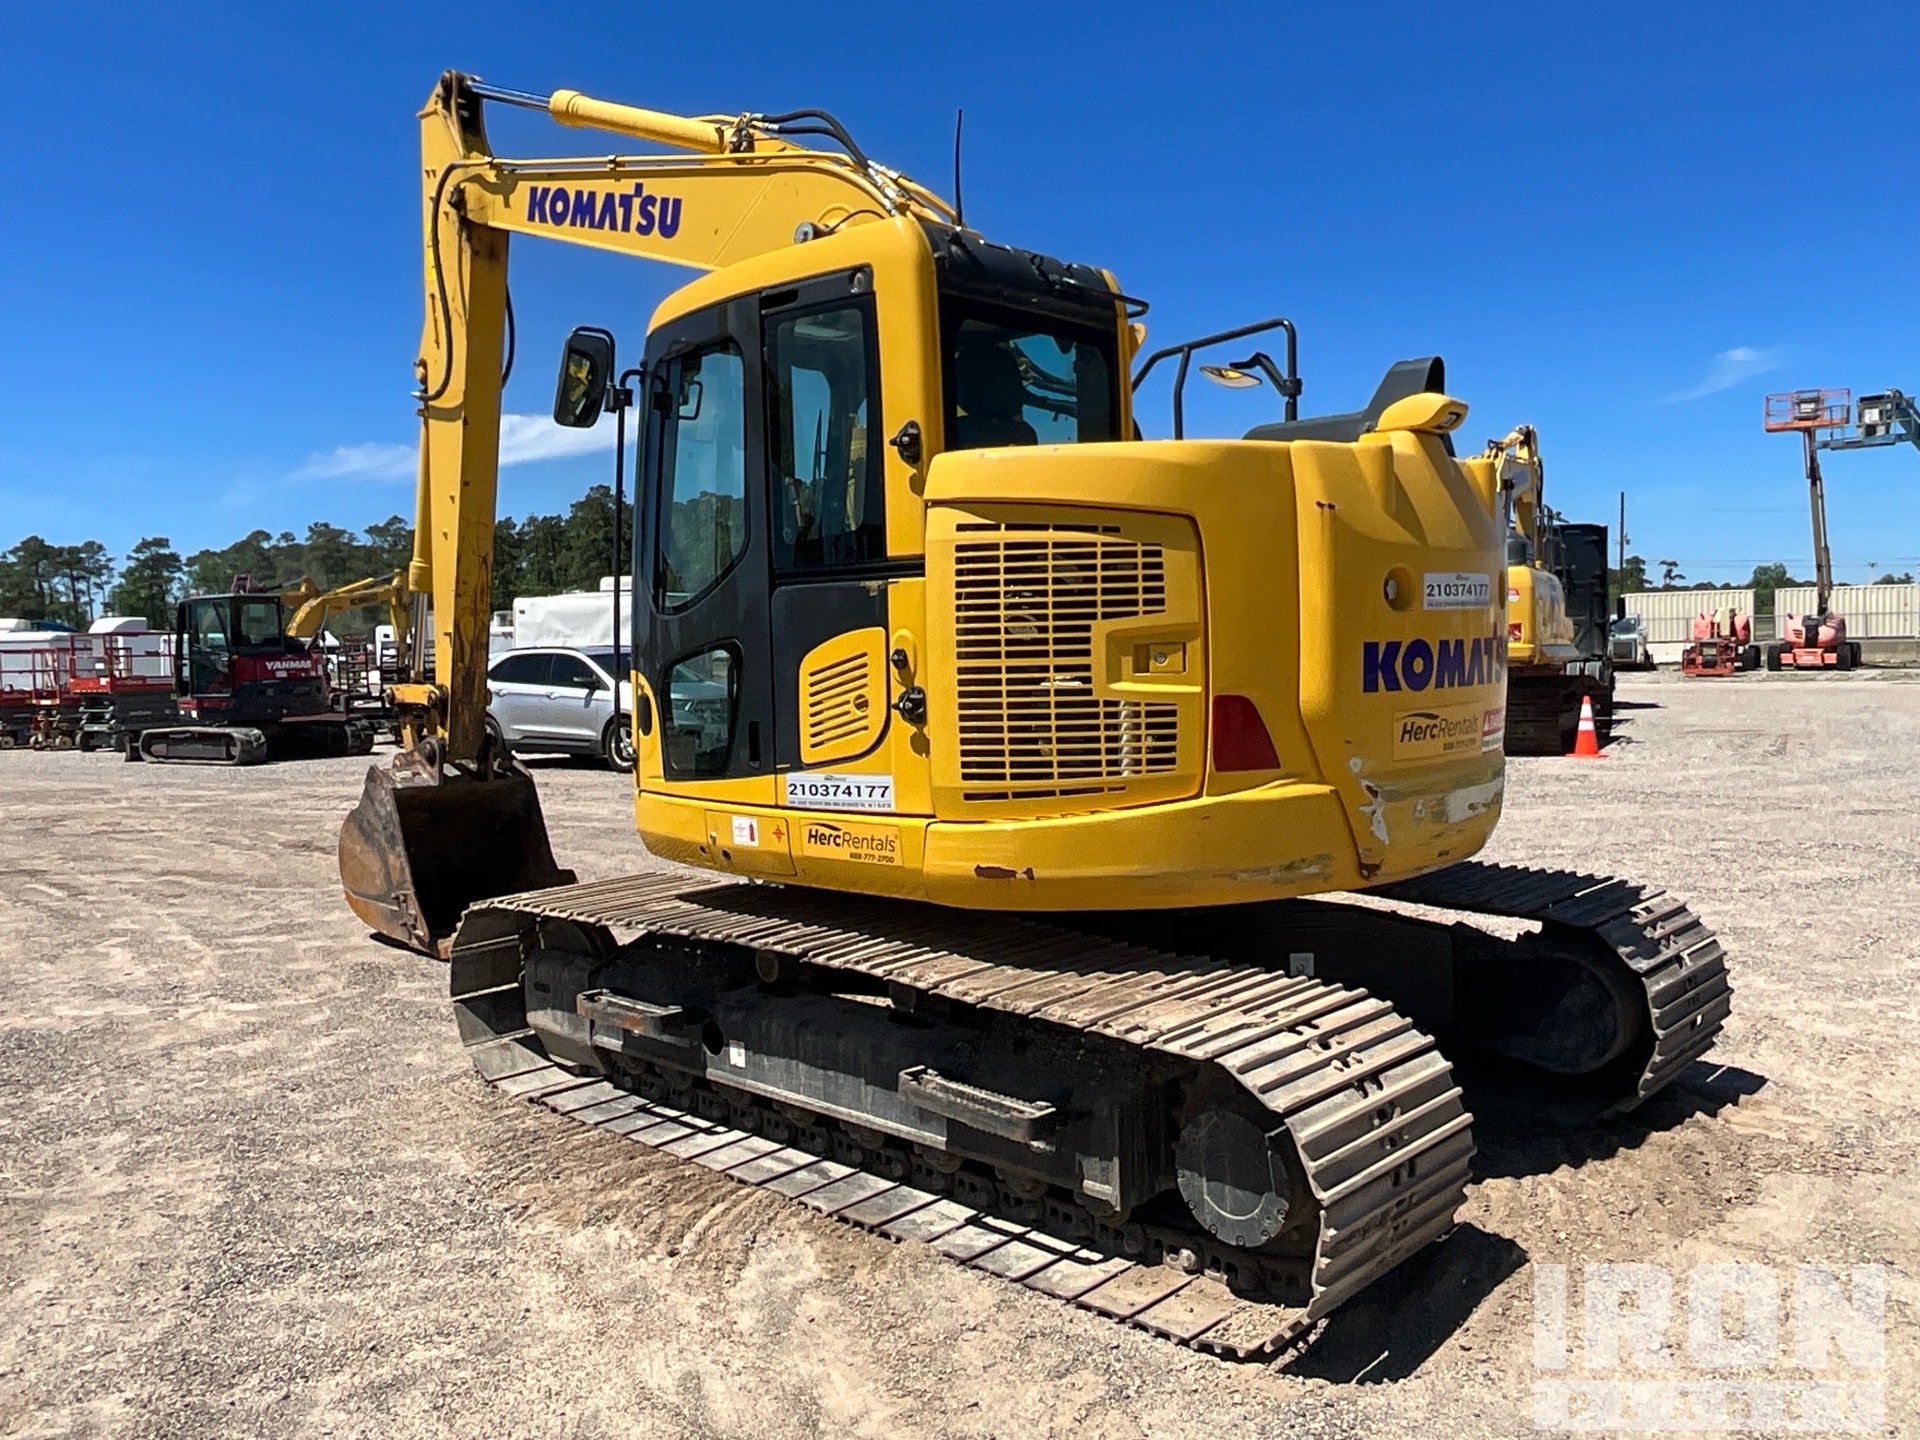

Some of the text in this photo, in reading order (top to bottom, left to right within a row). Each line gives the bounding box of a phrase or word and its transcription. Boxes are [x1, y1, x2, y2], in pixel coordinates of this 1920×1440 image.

[527, 182, 682, 239] KOMATSU
[1426, 583, 1489, 597] 210374177
[1362, 622, 1505, 692] KOMATS
[788, 783, 890, 798] 210374177
[807, 828, 896, 853] HercRentals
